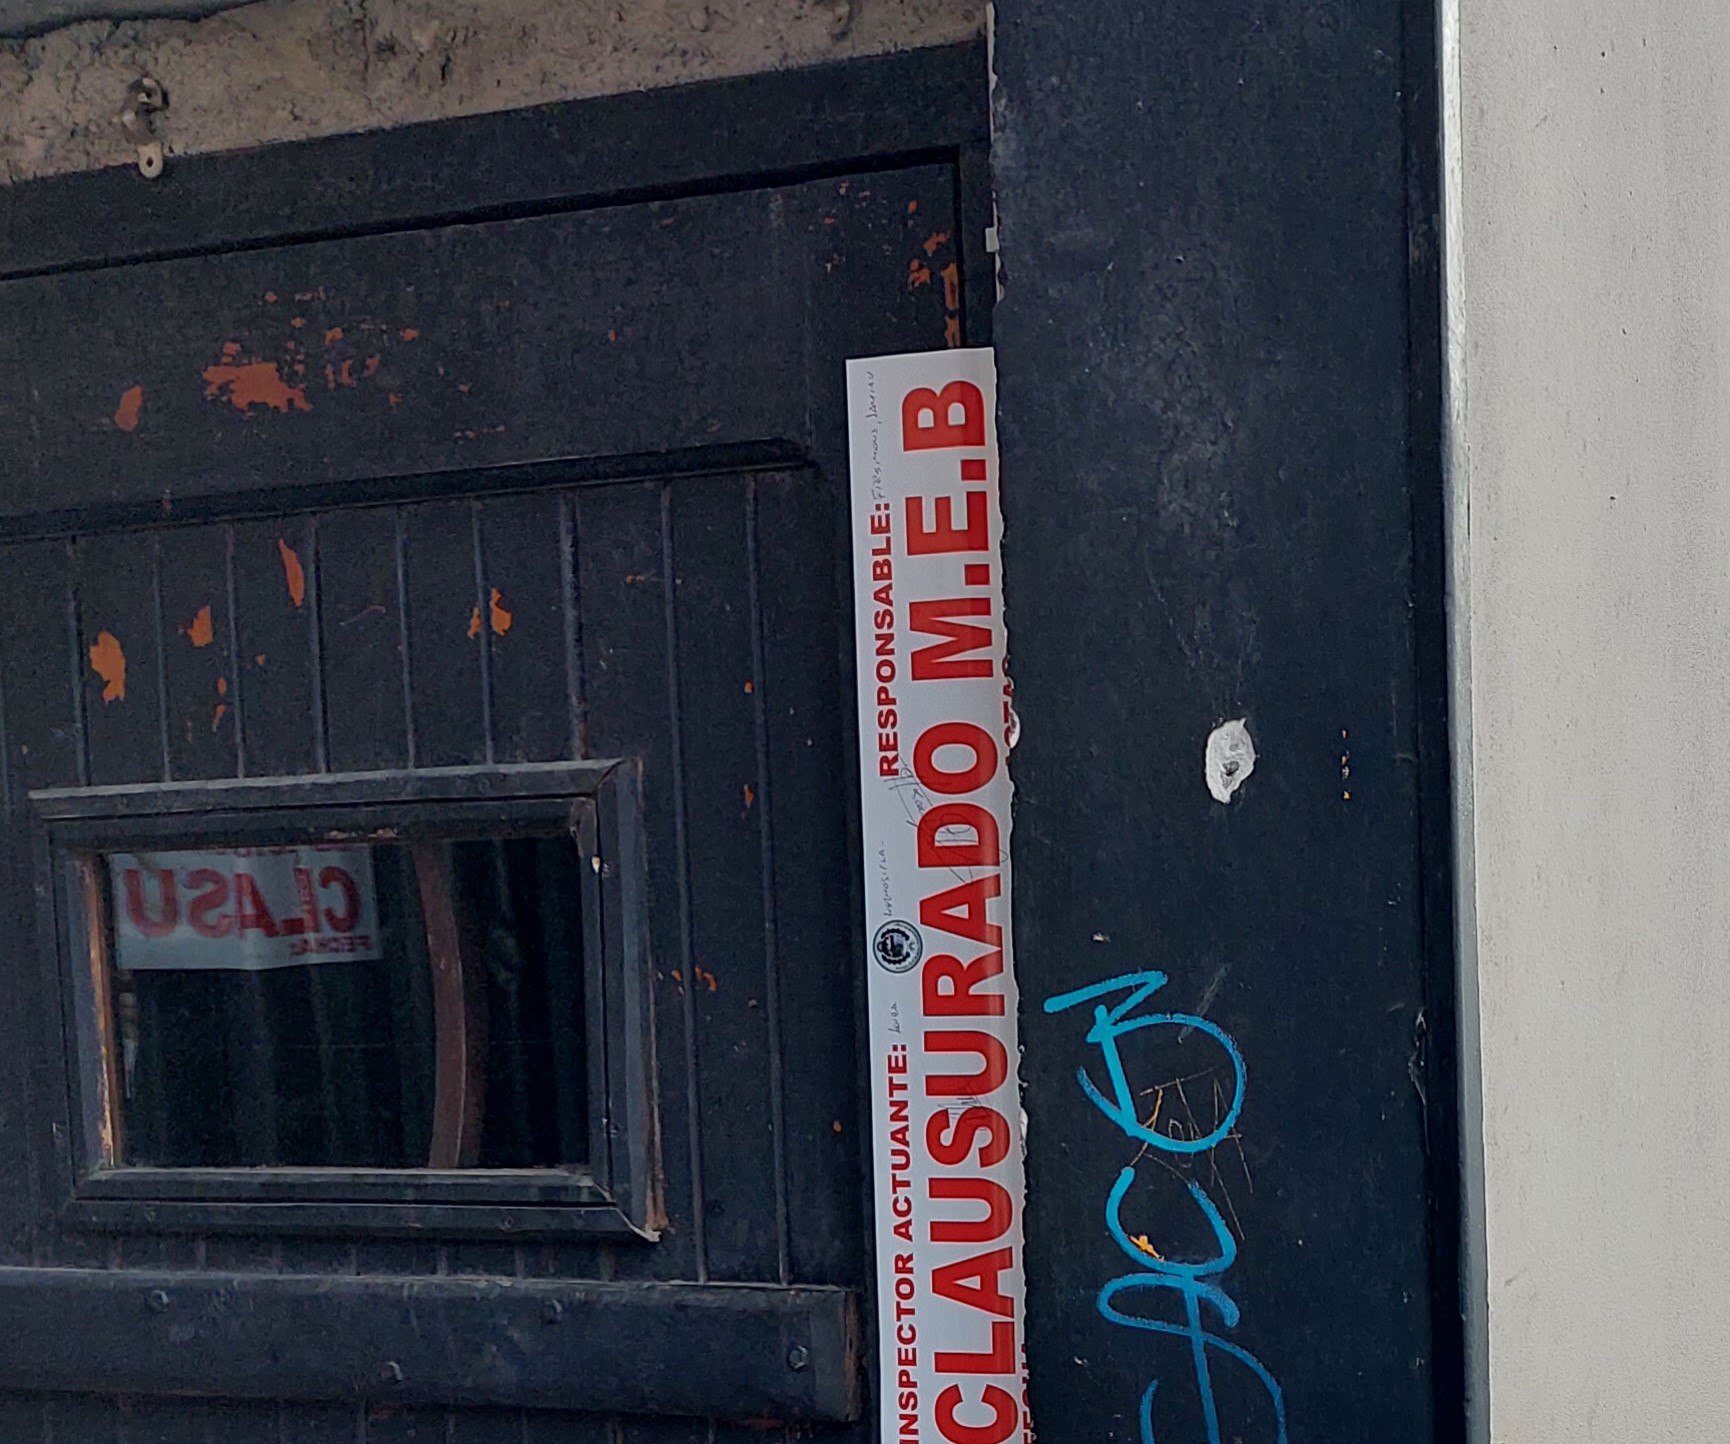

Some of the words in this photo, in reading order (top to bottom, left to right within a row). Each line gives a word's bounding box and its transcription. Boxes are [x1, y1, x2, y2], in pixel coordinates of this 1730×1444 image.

[870, 502, 900, 777] RESPONSABLE:
[901, 380, 995, 682] M.E.B
[887, 1044, 914, 1242] ACTUANTE:
